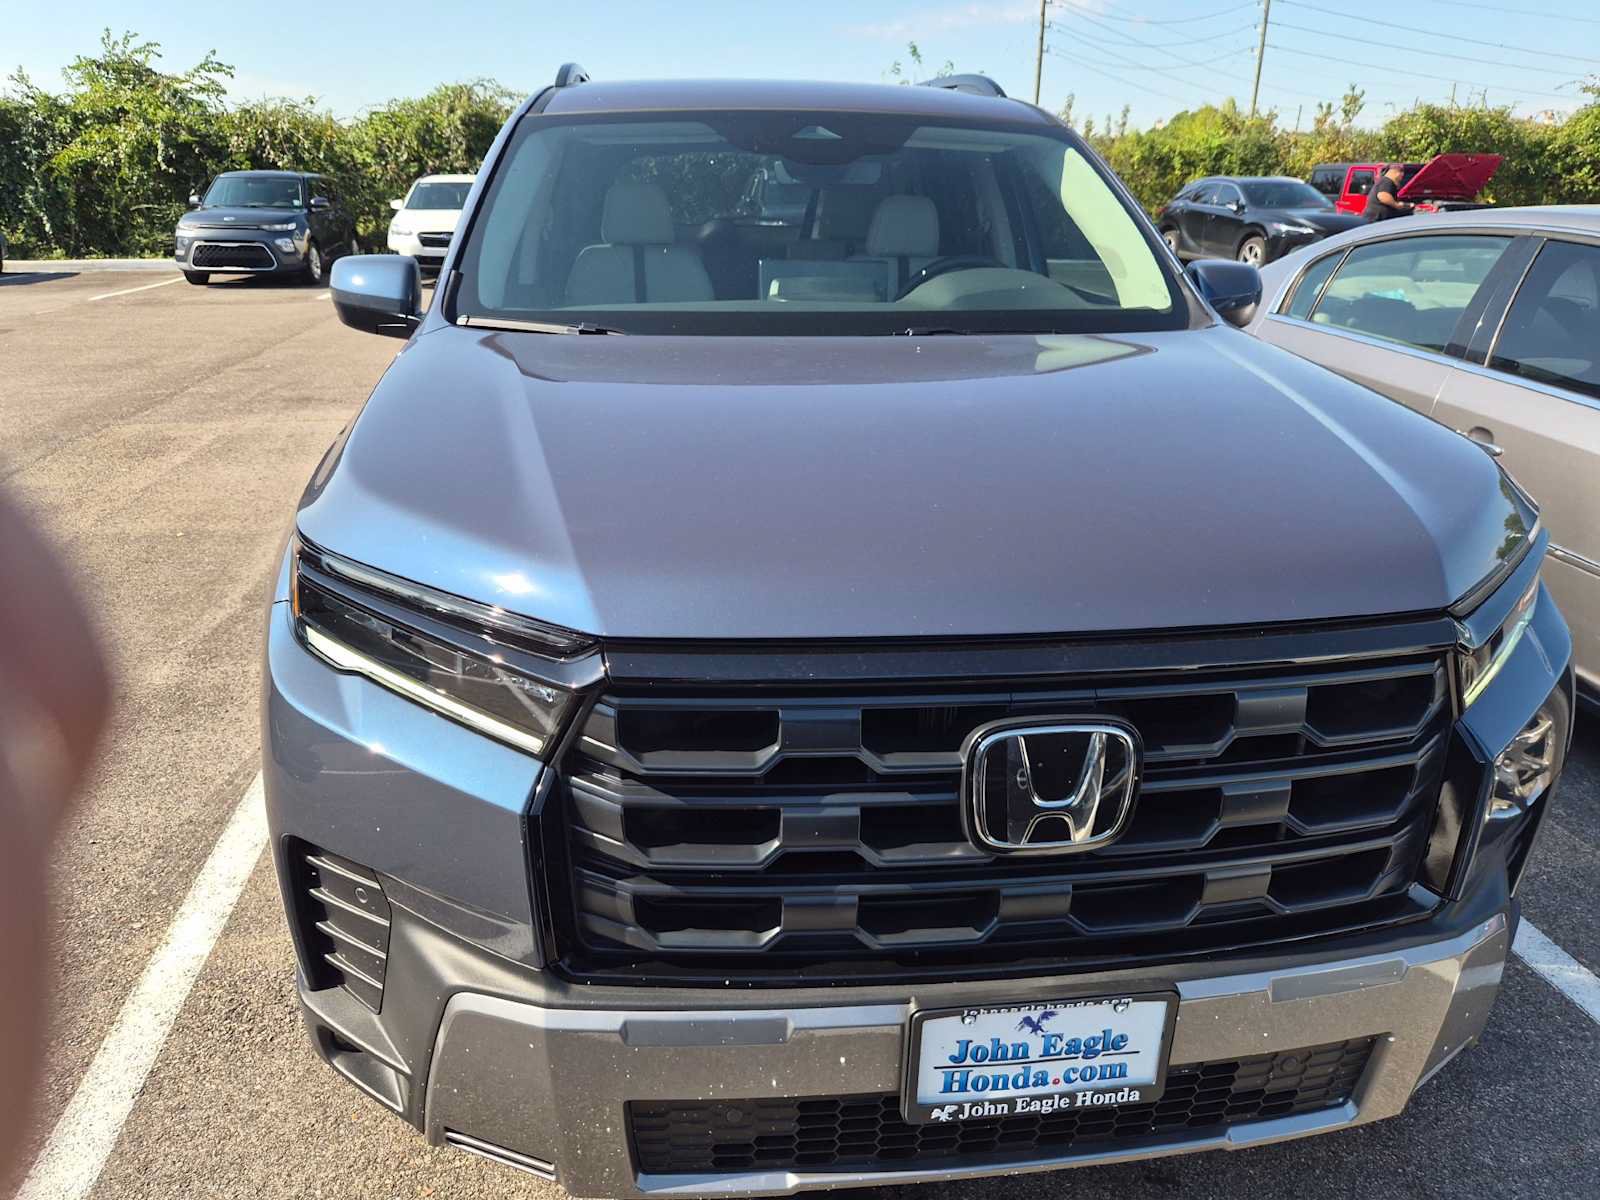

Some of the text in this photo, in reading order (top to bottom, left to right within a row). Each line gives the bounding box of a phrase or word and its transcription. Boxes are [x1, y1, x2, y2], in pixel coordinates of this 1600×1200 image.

[948, 1028, 1129, 1065] John Eagle
[938, 1061, 1129, 1094] Honda.com
[958, 1087, 1140, 1121] John Eagle Honda
